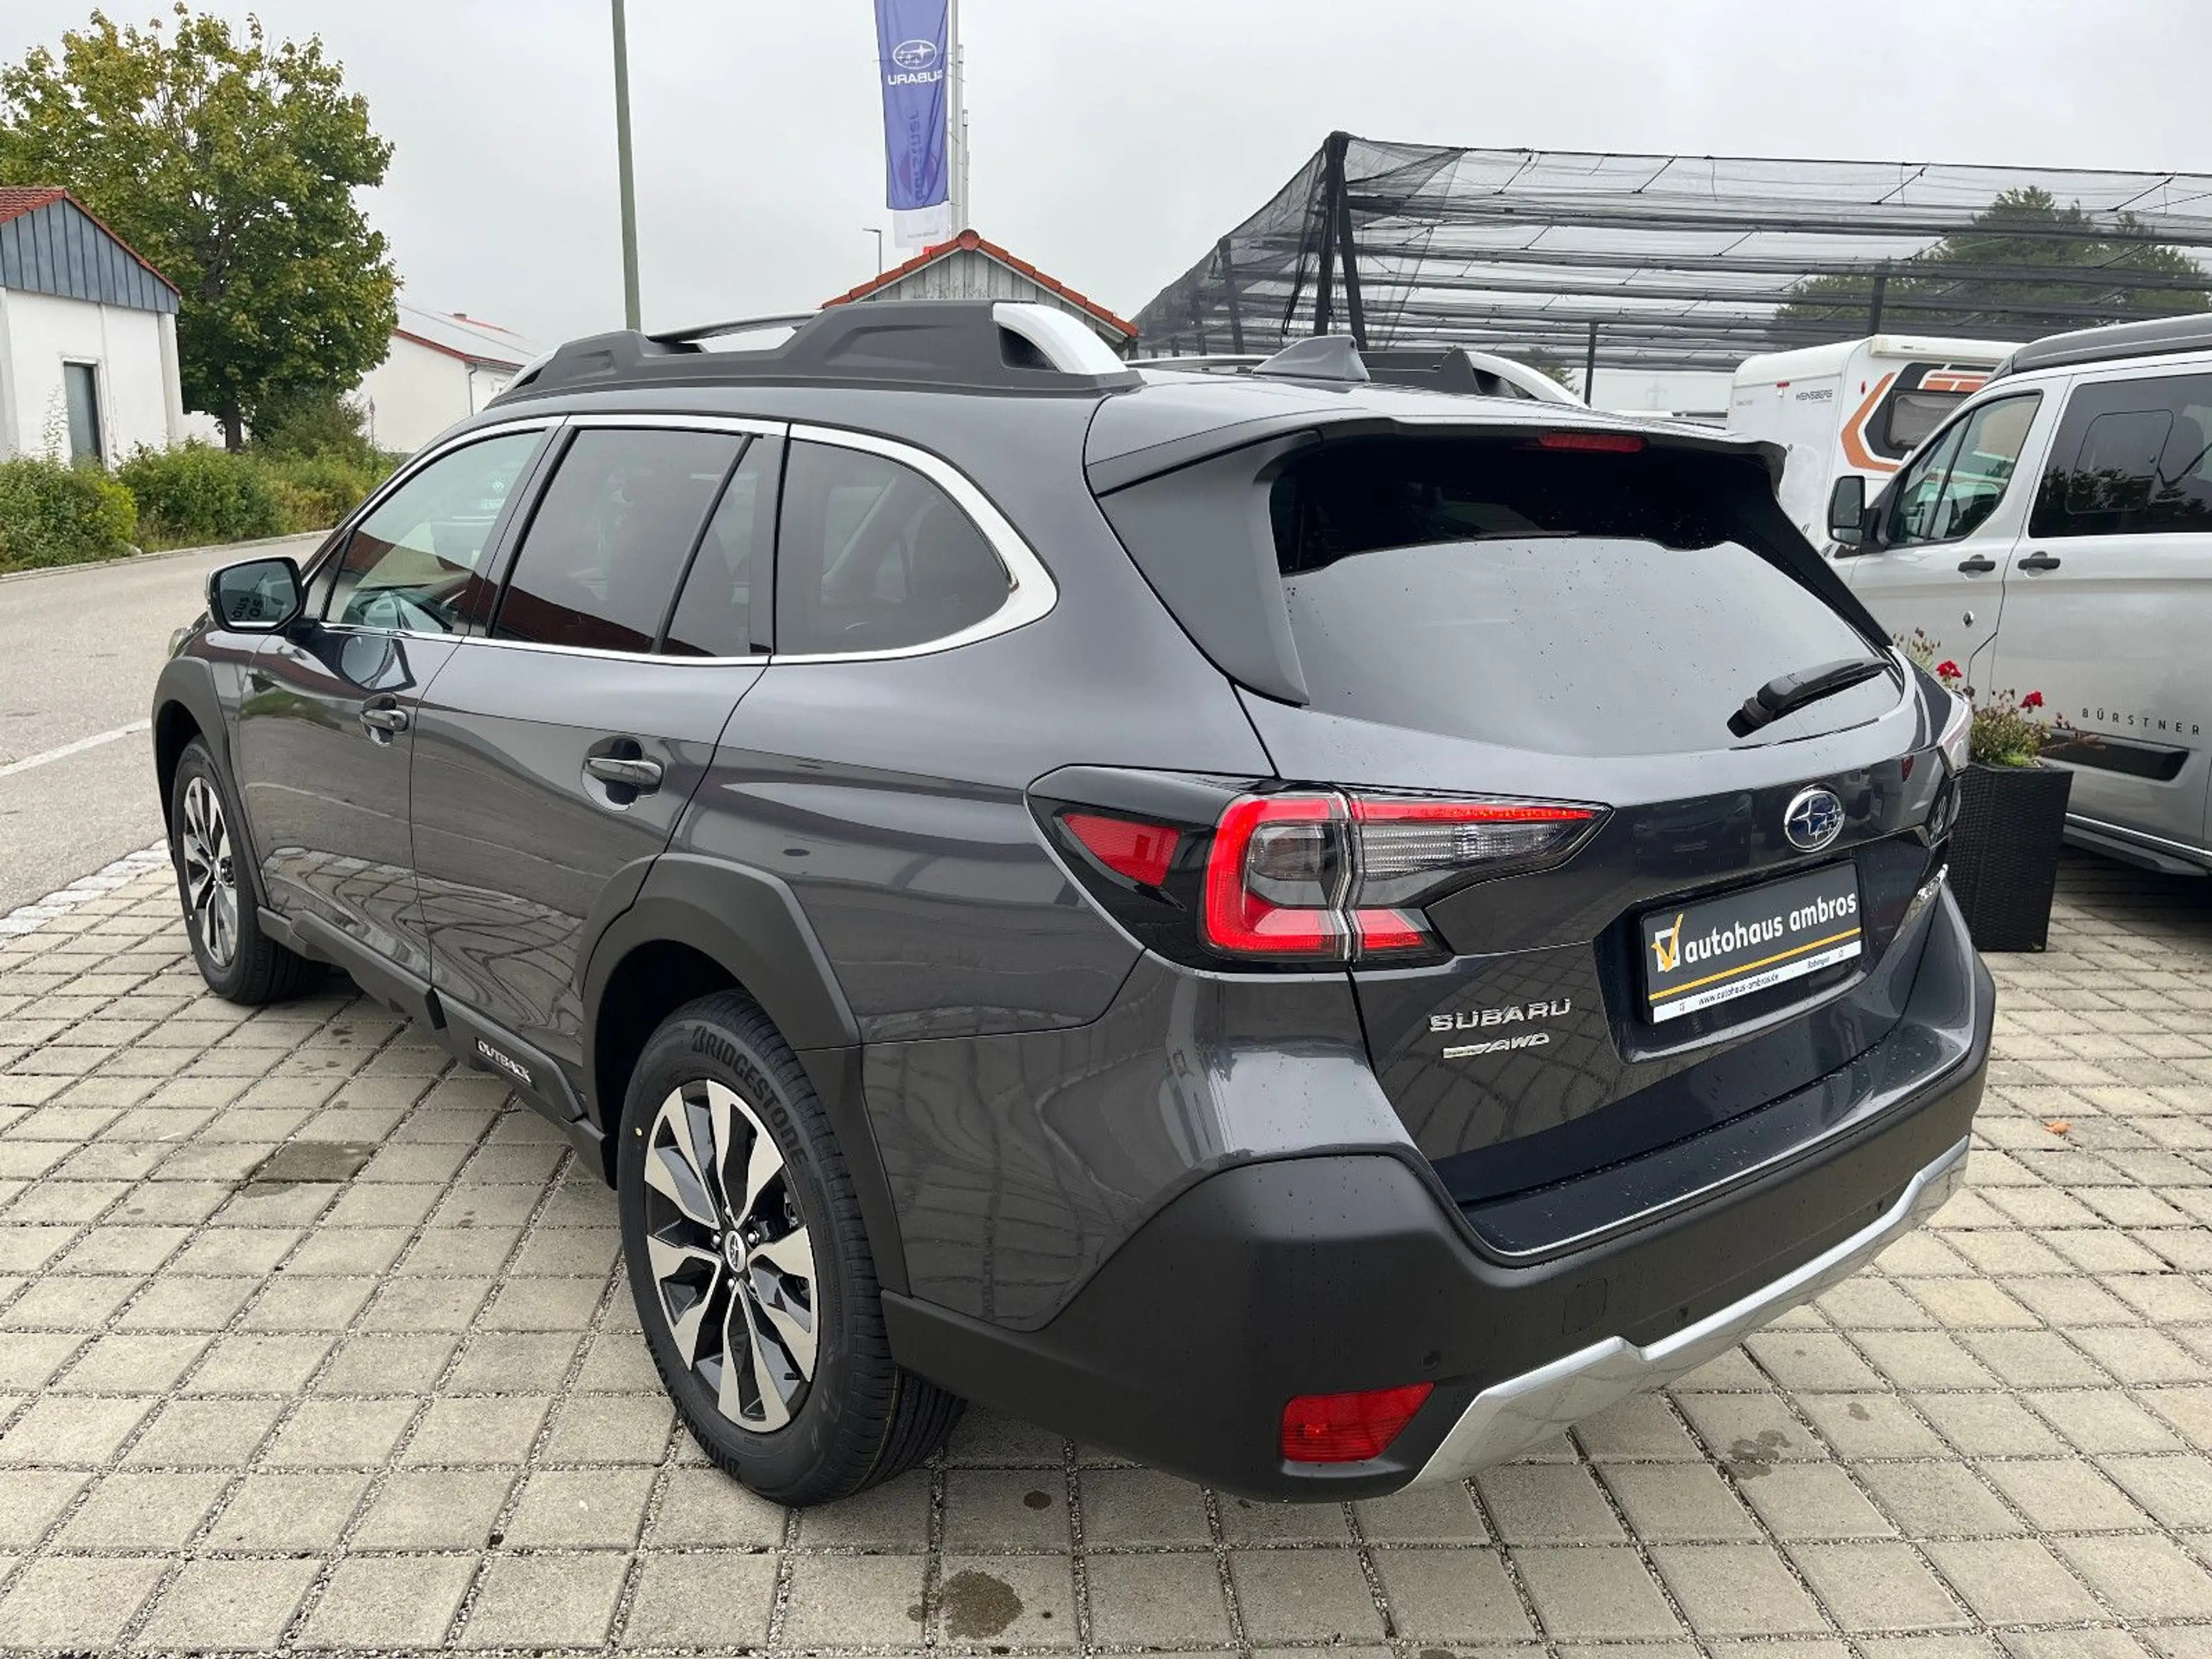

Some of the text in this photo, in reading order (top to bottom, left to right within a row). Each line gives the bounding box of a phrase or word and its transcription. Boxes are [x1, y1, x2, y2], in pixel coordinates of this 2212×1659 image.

[2082, 708, 2200, 735] BÜRSTNER
[1685, 893, 1856, 963] autohaus ambros
[1429, 998, 1571, 1032] SUBARU
[478, 1040, 531, 1083] OUTBACK
[1485, 1033, 1550, 1053] AWD
[692, 1025, 809, 1168] BRIDGESTONE
